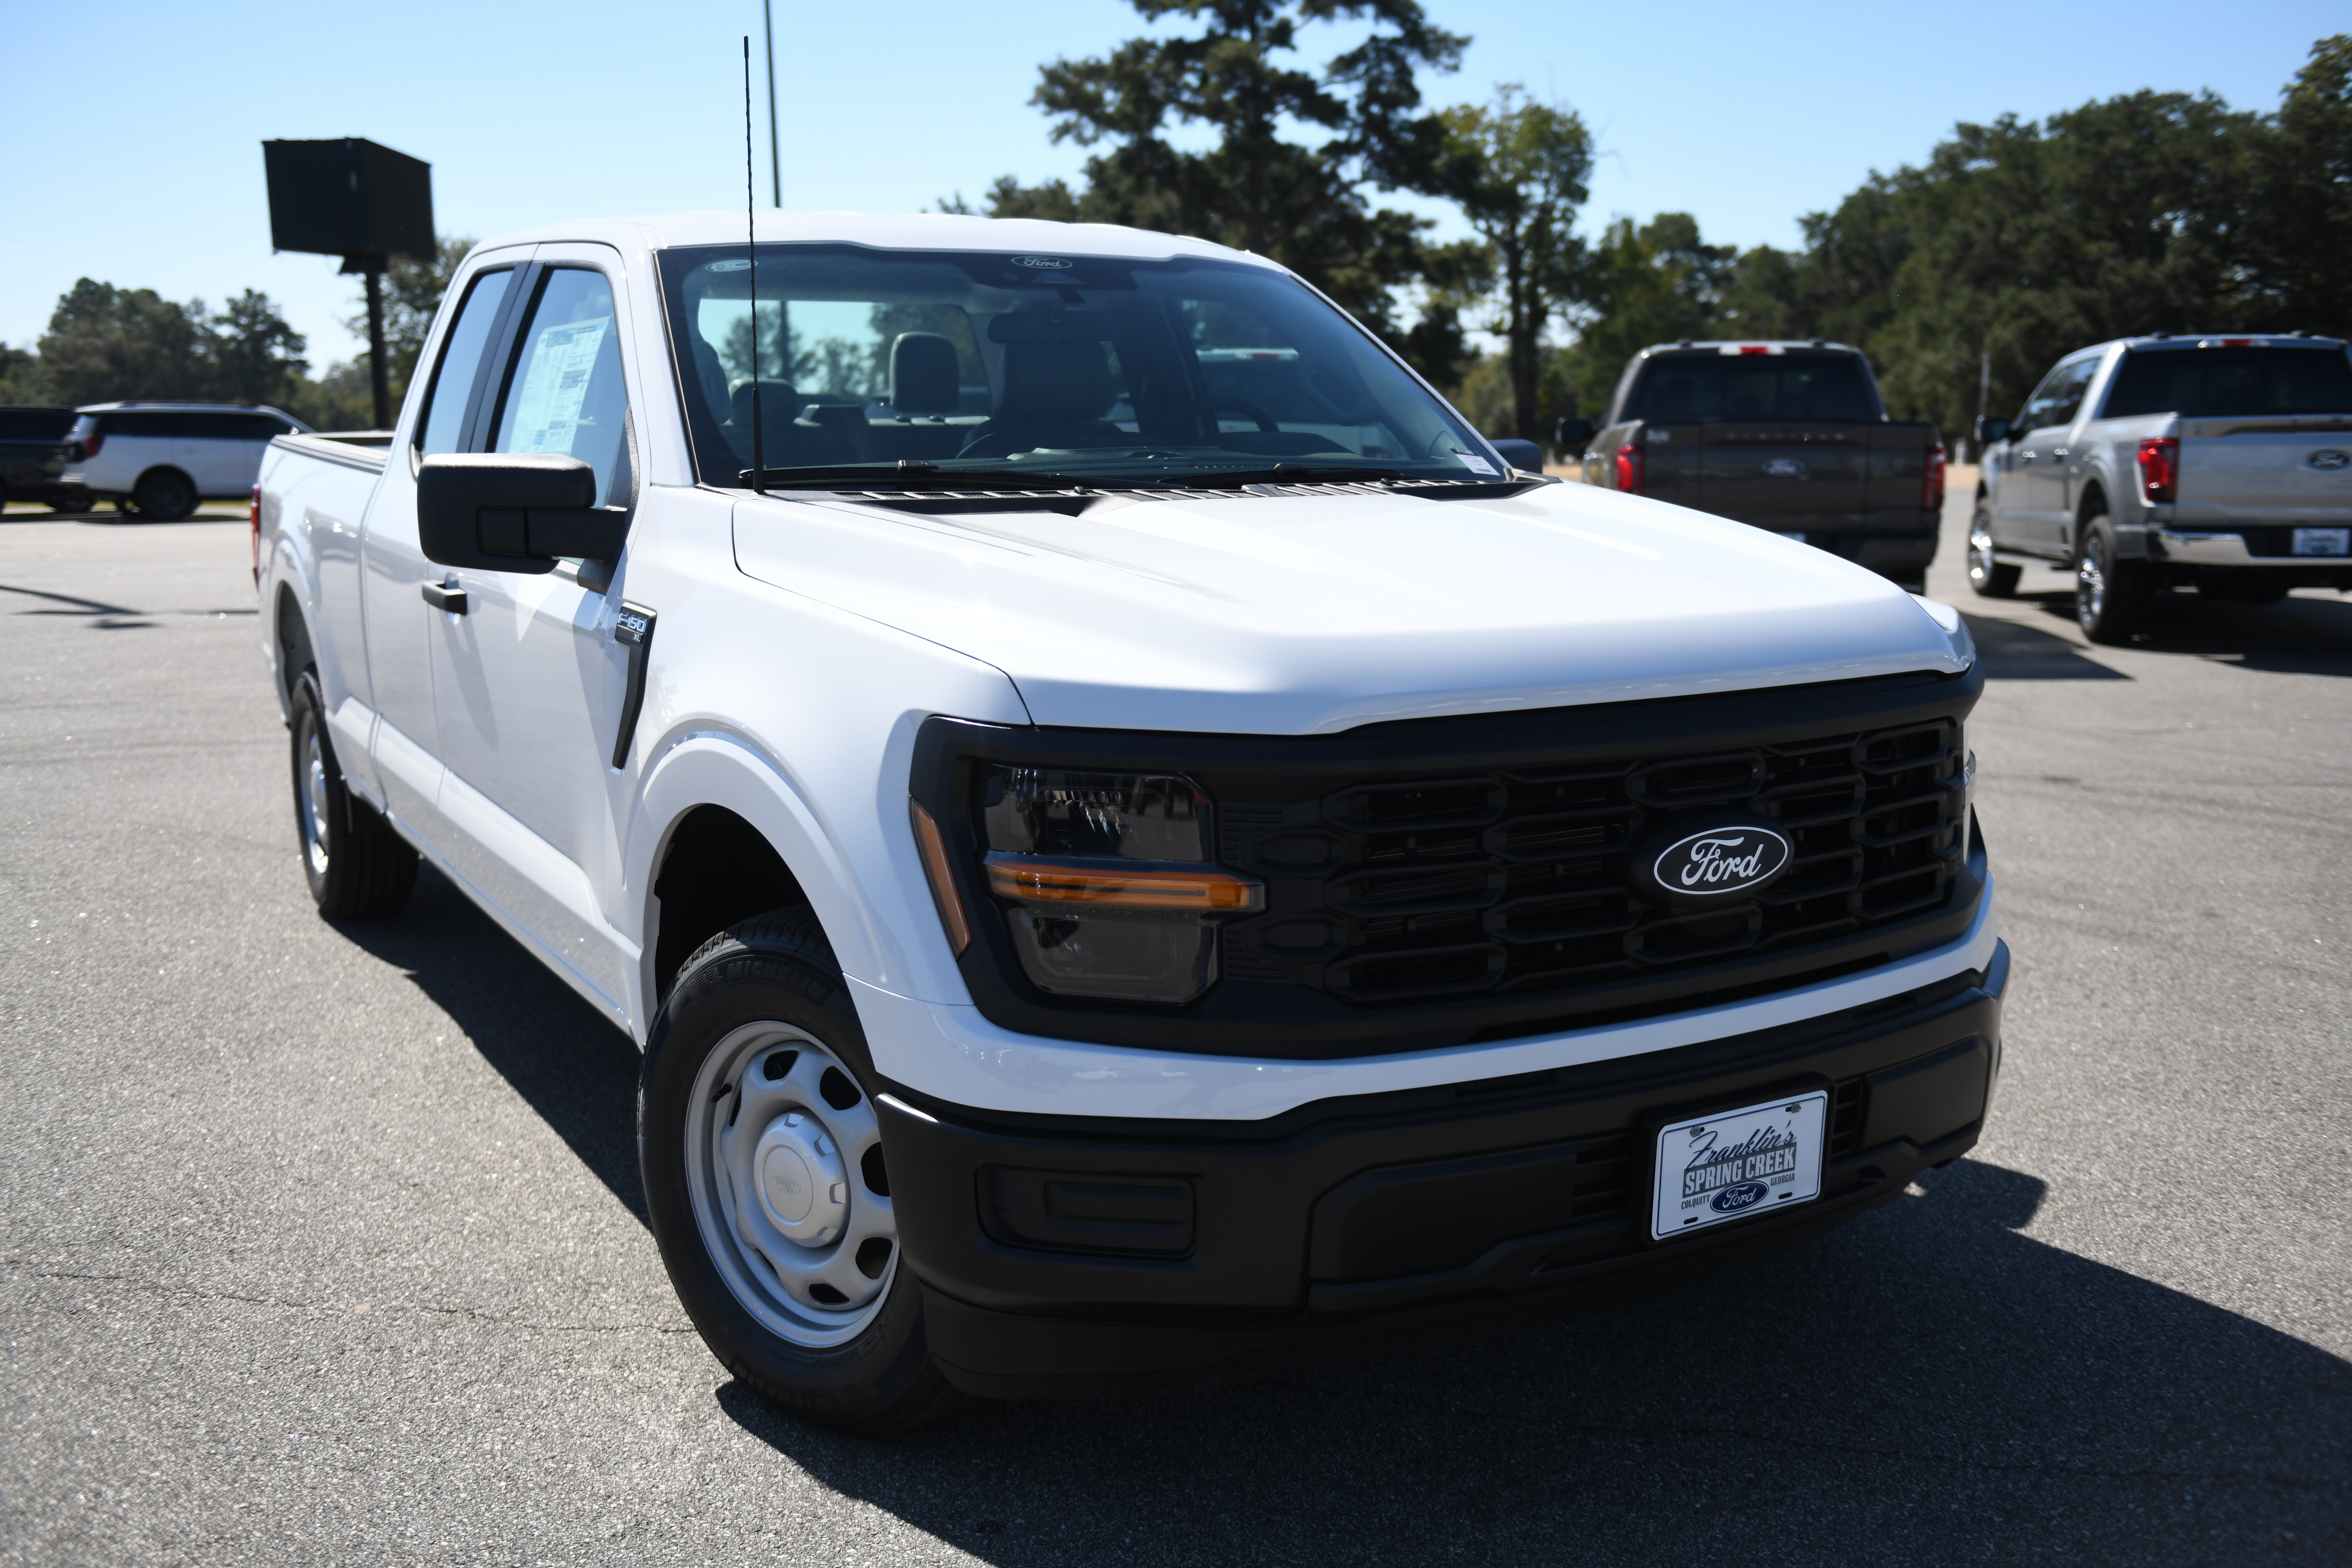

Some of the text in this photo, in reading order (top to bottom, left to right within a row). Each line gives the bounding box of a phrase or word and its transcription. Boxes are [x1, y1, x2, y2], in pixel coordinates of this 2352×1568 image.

[1024, 257, 1062, 267] Ford
[617, 612, 647, 633] F-150
[633, 633, 640, 642] XL
[1681, 836, 1764, 885] Ford
[727, 960, 826, 1000] MICHELIN
[1685, 1119, 1796, 1171] Franklin's
[1685, 1147, 1795, 1195] SPRING CREEK
[1770, 1172, 1795, 1186] GEORGIA
[776, 1177, 795, 1193] Ford
[1681, 1194, 1711, 1209] COLQUITT
[1722, 1185, 1757, 1208] Ford
